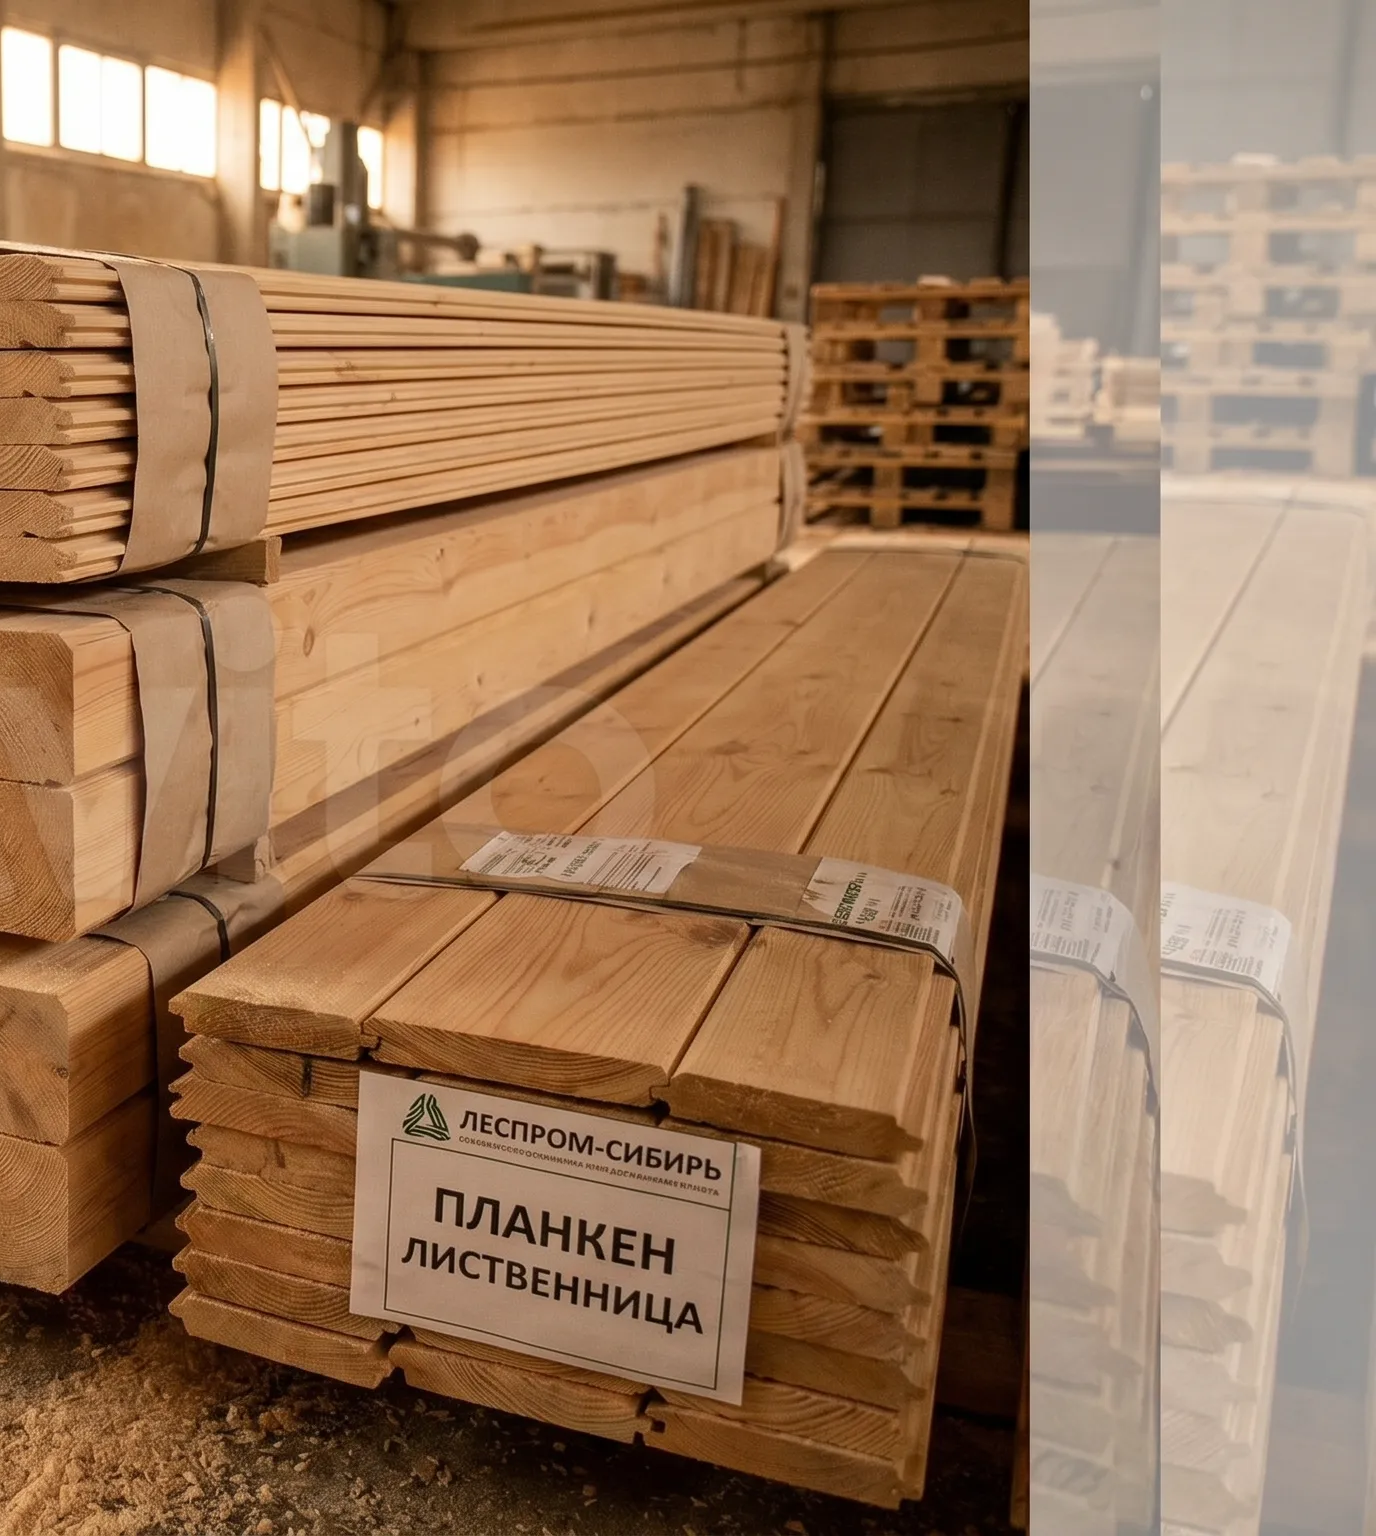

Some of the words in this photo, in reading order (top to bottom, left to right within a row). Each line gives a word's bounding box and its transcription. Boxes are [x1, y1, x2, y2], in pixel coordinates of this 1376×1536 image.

[459, 1110, 722, 1181] ЛЕСПРОМ-СИБИРЬ
[434, 1187, 675, 1275] ПЛАНКЕН
[401, 1237, 704, 1335] ЛИСТВЕННИЦА
